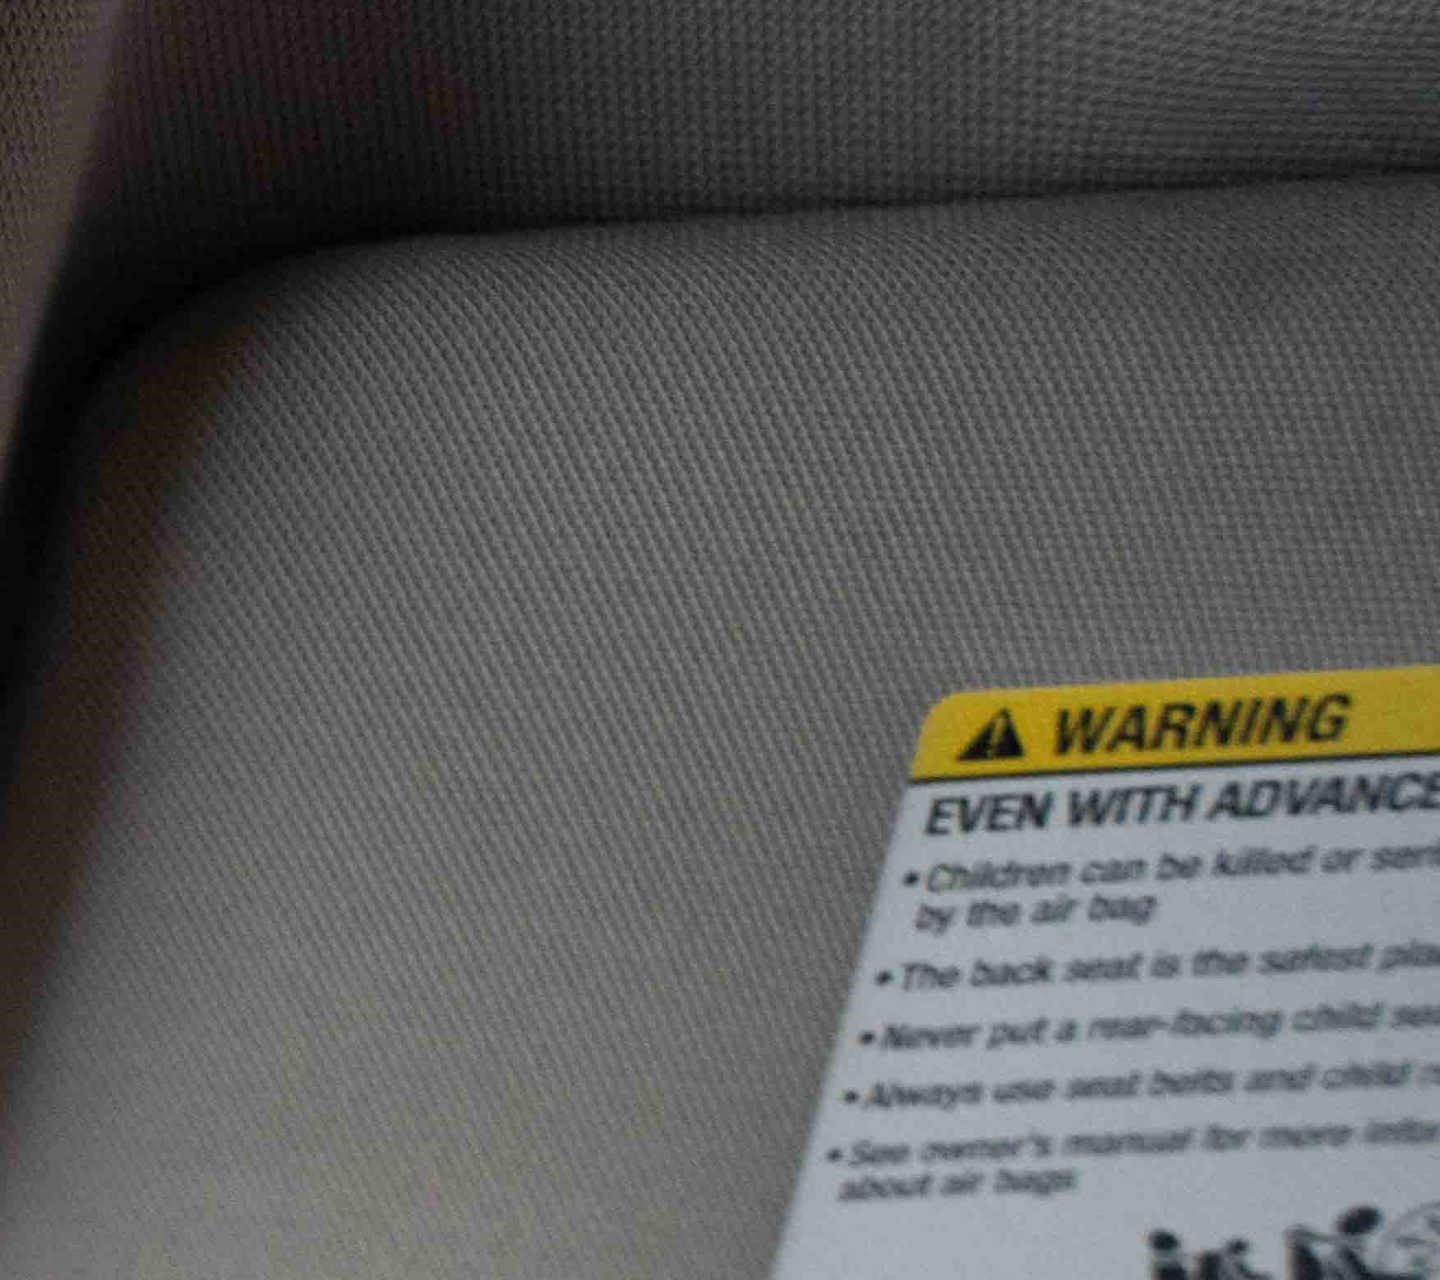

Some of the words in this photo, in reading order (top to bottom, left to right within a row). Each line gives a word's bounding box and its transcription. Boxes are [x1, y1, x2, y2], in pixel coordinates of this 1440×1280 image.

[1053, 693, 1351, 755] WARNING
[925, 790, 1054, 836] EVEN
[1068, 783, 1202, 827] WITH
[927, 859, 1072, 893] Children
[1080, 857, 1148, 885] can
[1155, 852, 1203, 881] be
[1212, 845, 1318, 875] killed
[1321, 846, 1366, 874] or
[915, 902, 955, 934] by
[966, 898, 1020, 927] the
[1031, 893, 1078, 924] air
[901, 961, 960, 990] The
[969, 956, 1054, 987] back
[1063, 951, 1144, 980] seat
[1150, 949, 1181, 979] is
[1191, 946, 1250, 976] the
[883, 1023, 980, 1050] Never
[985, 1017, 1050, 1049] put
[1054, 1019, 1077, 1041] a
[864, 1080, 985, 1112] Always
[993, 1078, 1056, 1105] use
